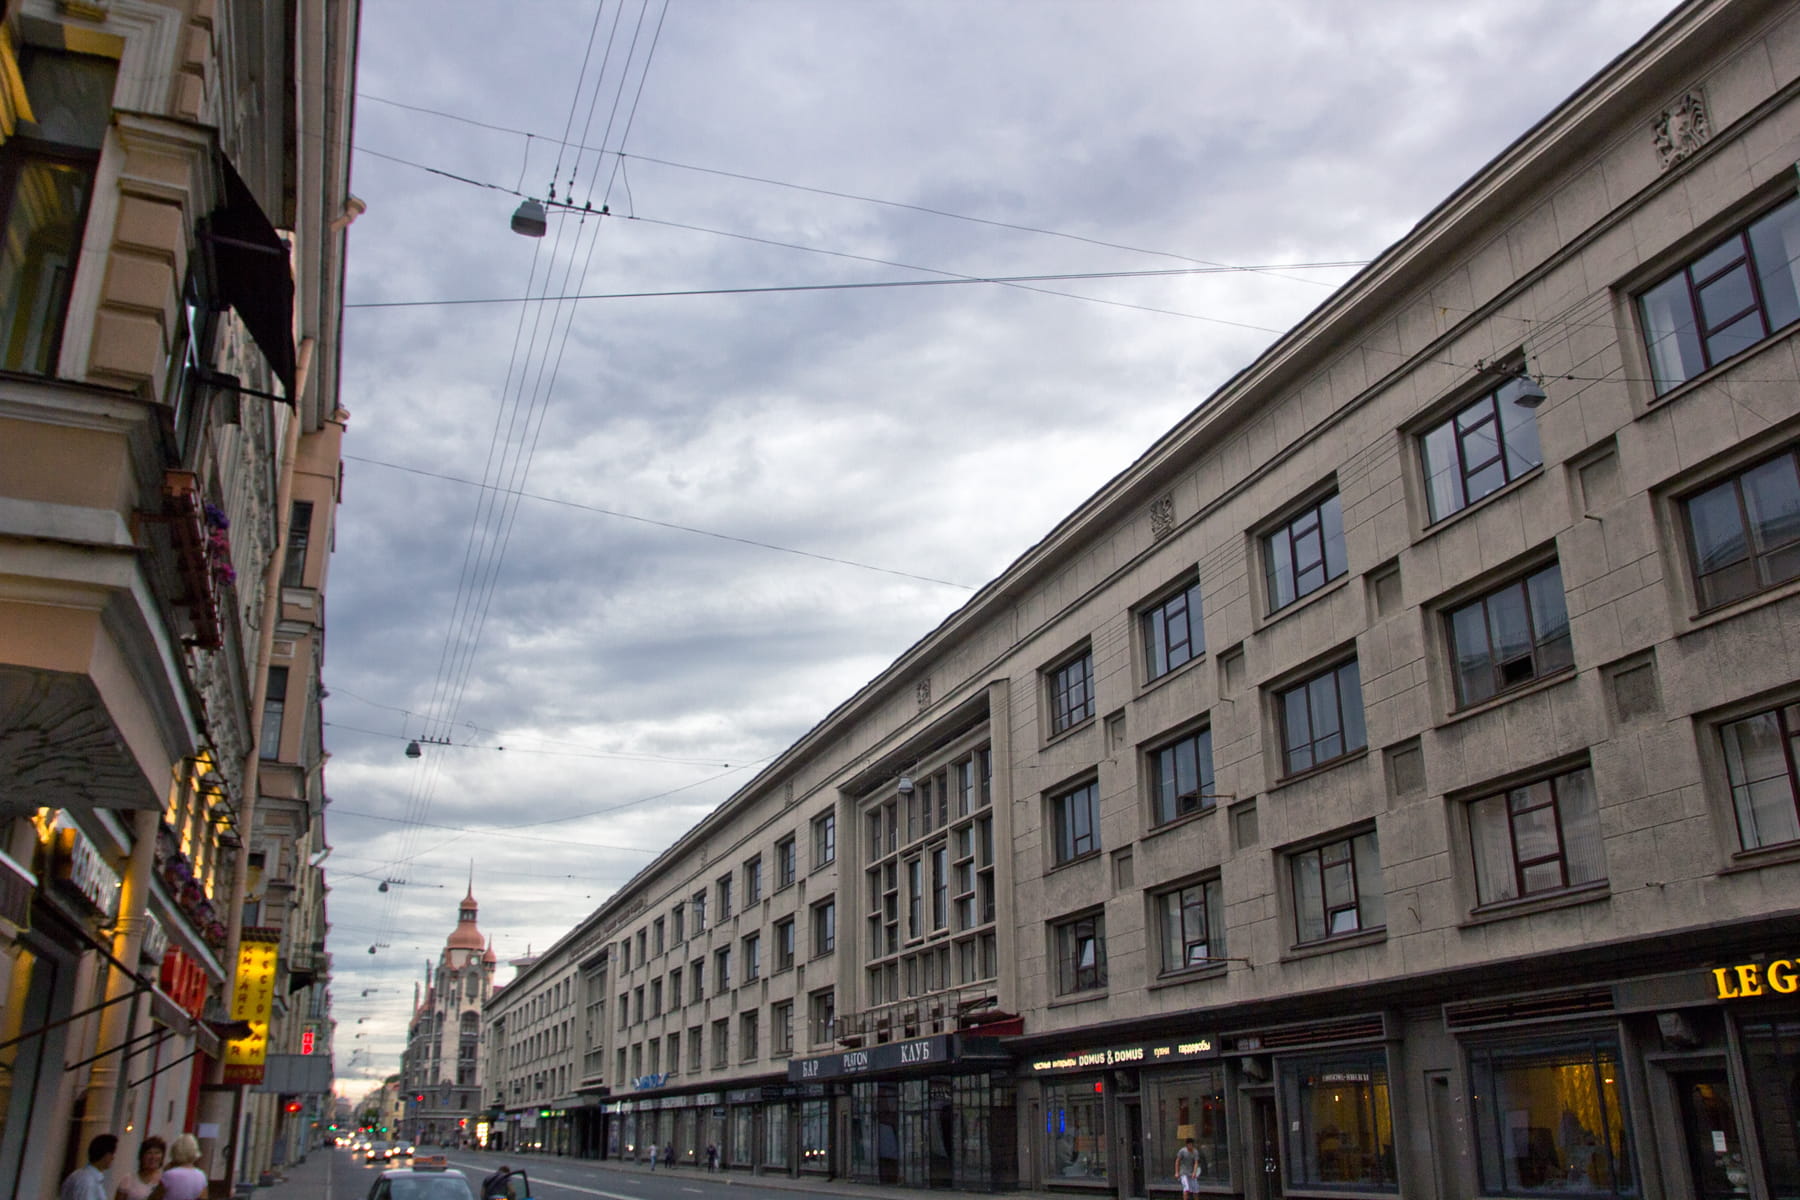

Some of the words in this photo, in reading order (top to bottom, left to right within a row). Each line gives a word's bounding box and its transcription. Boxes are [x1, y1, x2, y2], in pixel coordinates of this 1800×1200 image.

[1712, 957, 1800, 999] LEG
[230, 945, 253, 1056] КИТАЙСЙ
[900, 1042, 930, 1063] КЛУБ
[1078, 1052, 1105, 1067] DOMUS
[1106, 1049, 1114, 1065] &
[1114, 1047, 1144, 1063] DOMUS
[802, 1060, 819, 1077] БАР
